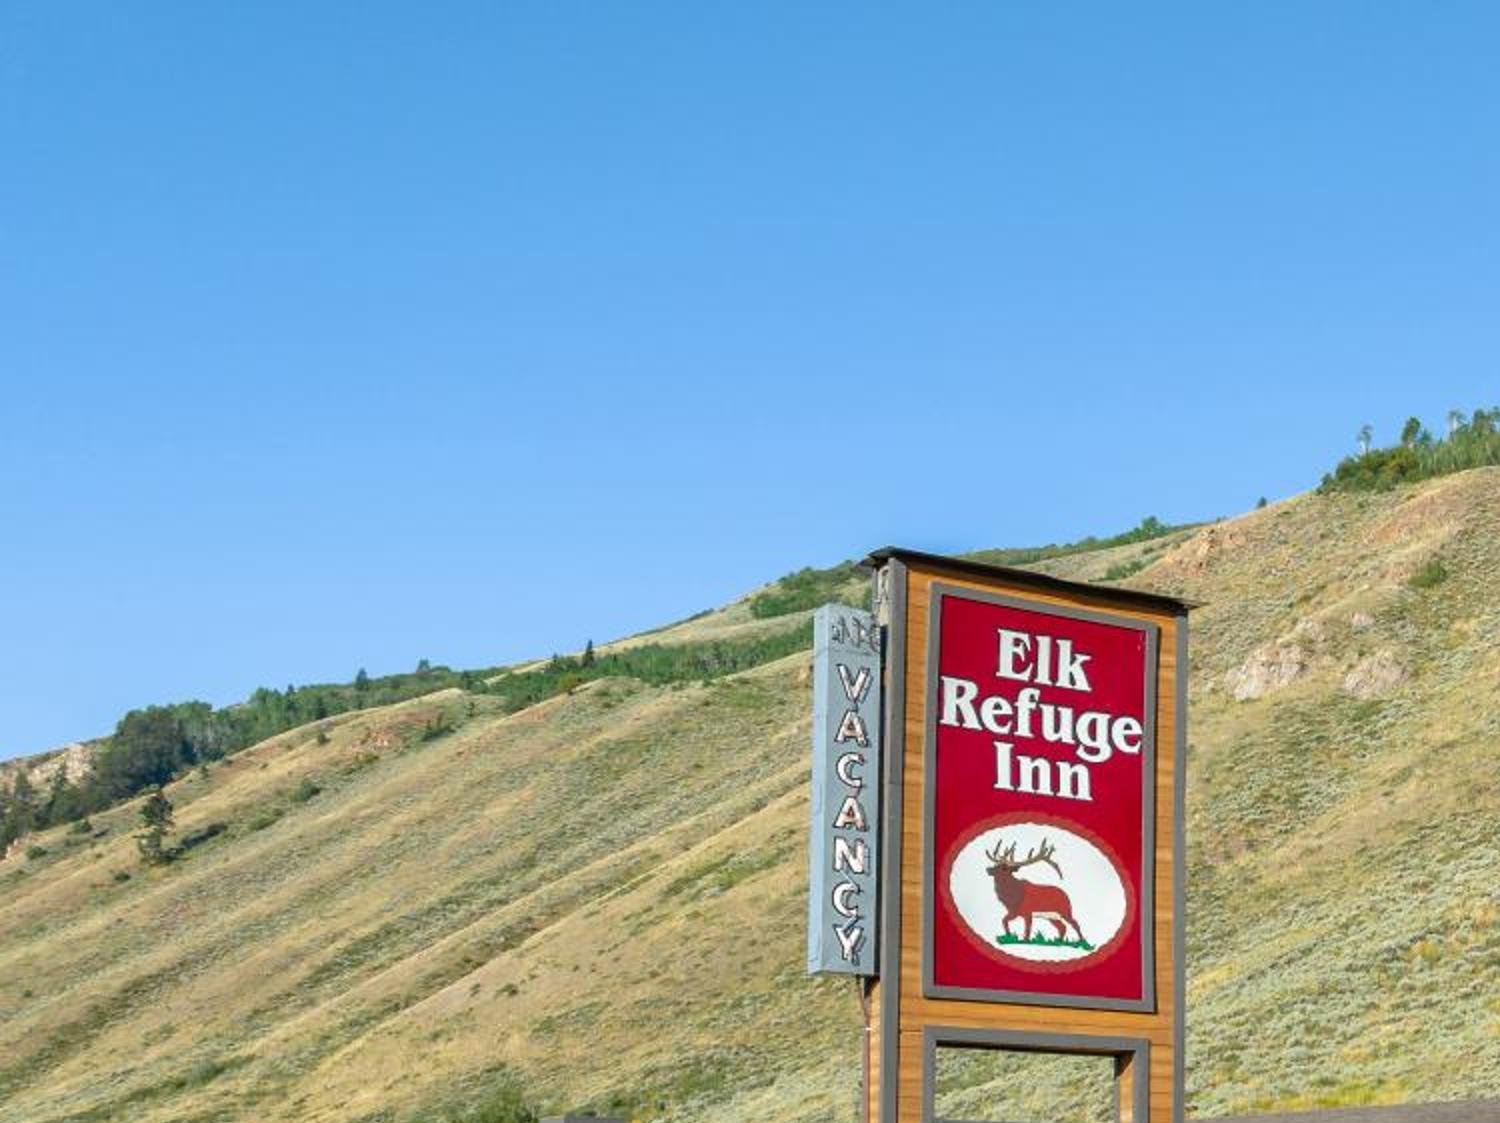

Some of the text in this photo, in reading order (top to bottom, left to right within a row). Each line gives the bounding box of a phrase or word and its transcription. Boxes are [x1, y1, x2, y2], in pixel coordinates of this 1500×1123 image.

[995, 628, 1092, 692] Elk
[939, 675, 1144, 764] Refuge
[992, 740, 1093, 801] Inn
[832, 663, 872, 966] VACANCY
